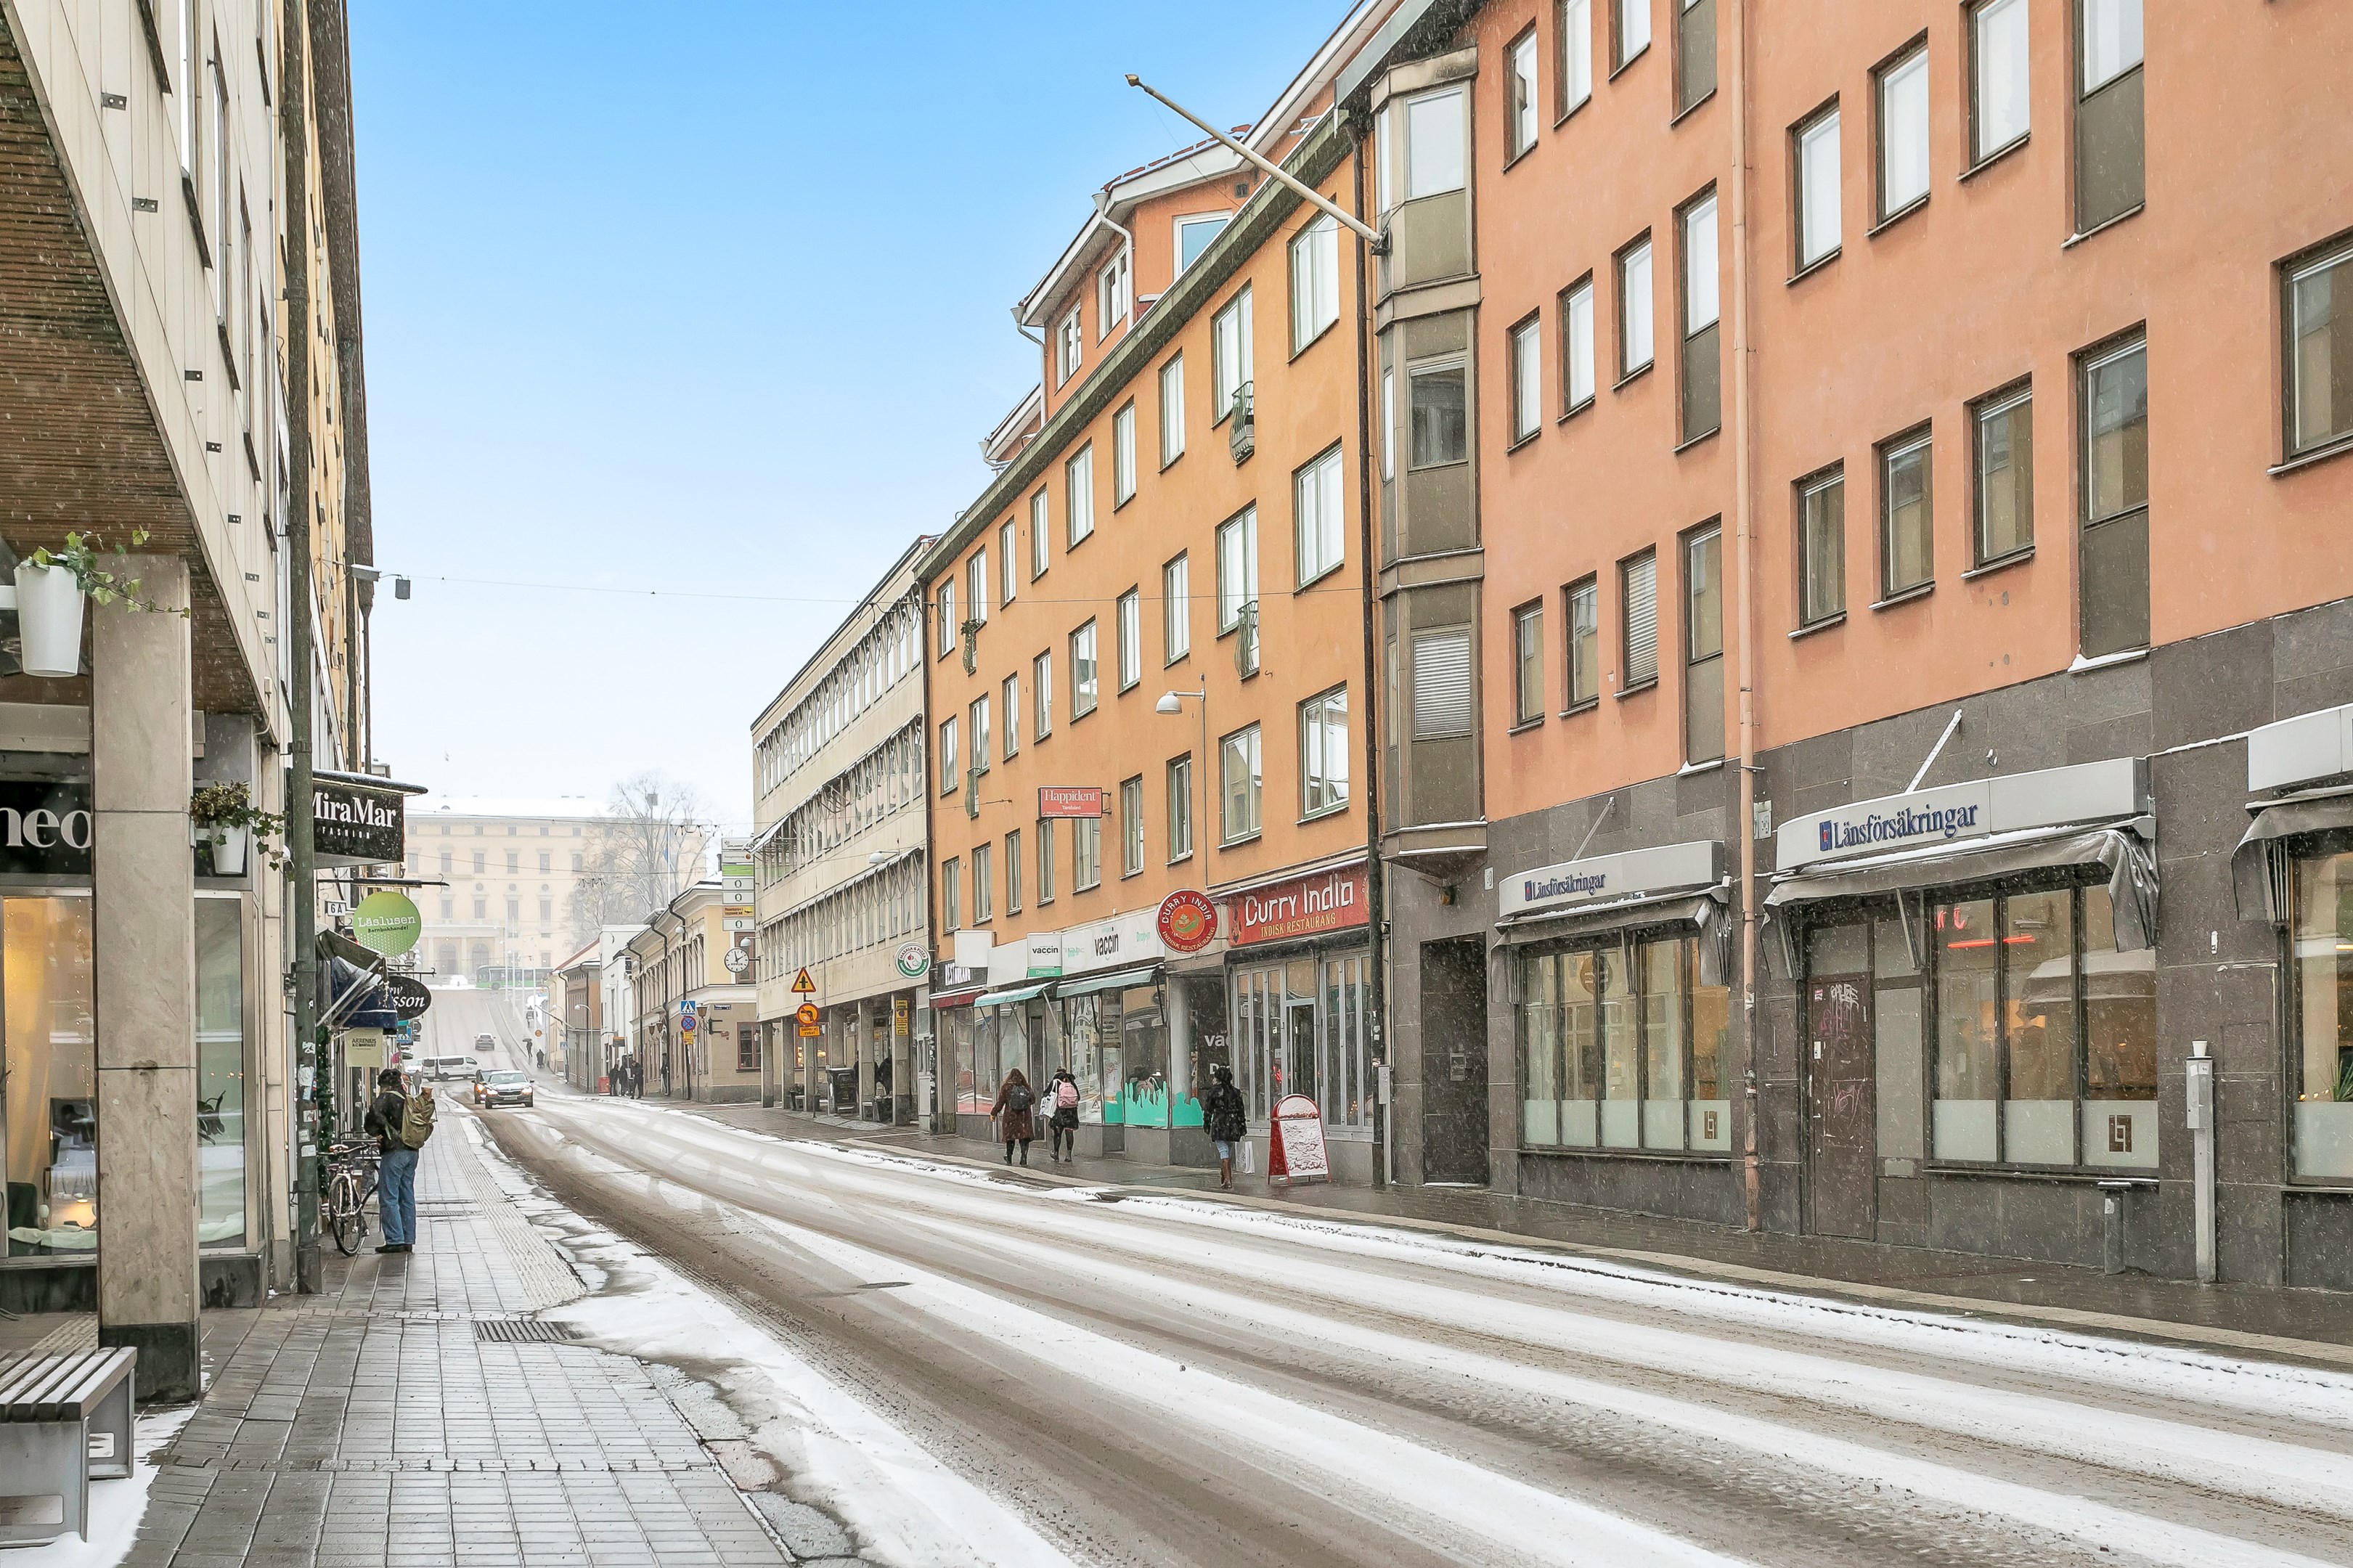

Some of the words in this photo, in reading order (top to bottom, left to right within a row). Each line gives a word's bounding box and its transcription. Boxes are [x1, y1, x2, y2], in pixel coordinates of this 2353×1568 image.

[1045, 790, 1096, 804] Happident
[322, 826, 370, 839] FASHION
[1833, 804, 1978, 849] Länsförsäkringar
[1532, 872, 1606, 902] Länsförsäkringar
[330, 903, 335, 913] 6
[338, 903, 343, 913] A
[1162, 895, 1187, 923] CURRY
[1191, 897, 1212, 920] INDIA
[1245, 894, 1297, 927] Curry
[1303, 873, 1354, 914] India
[358, 916, 416, 928] Läslusen
[1261, 923, 1285, 938] INDISK
[1286, 912, 1336, 934] RESTAURANG
[1095, 927, 1119, 956] vaccin
[1162, 931, 1180, 949] INDISK
[1180, 926, 1215, 950] RESTAURANG
[900, 947, 913, 959] MASALA
[917, 947, 926, 958] PIZZA
